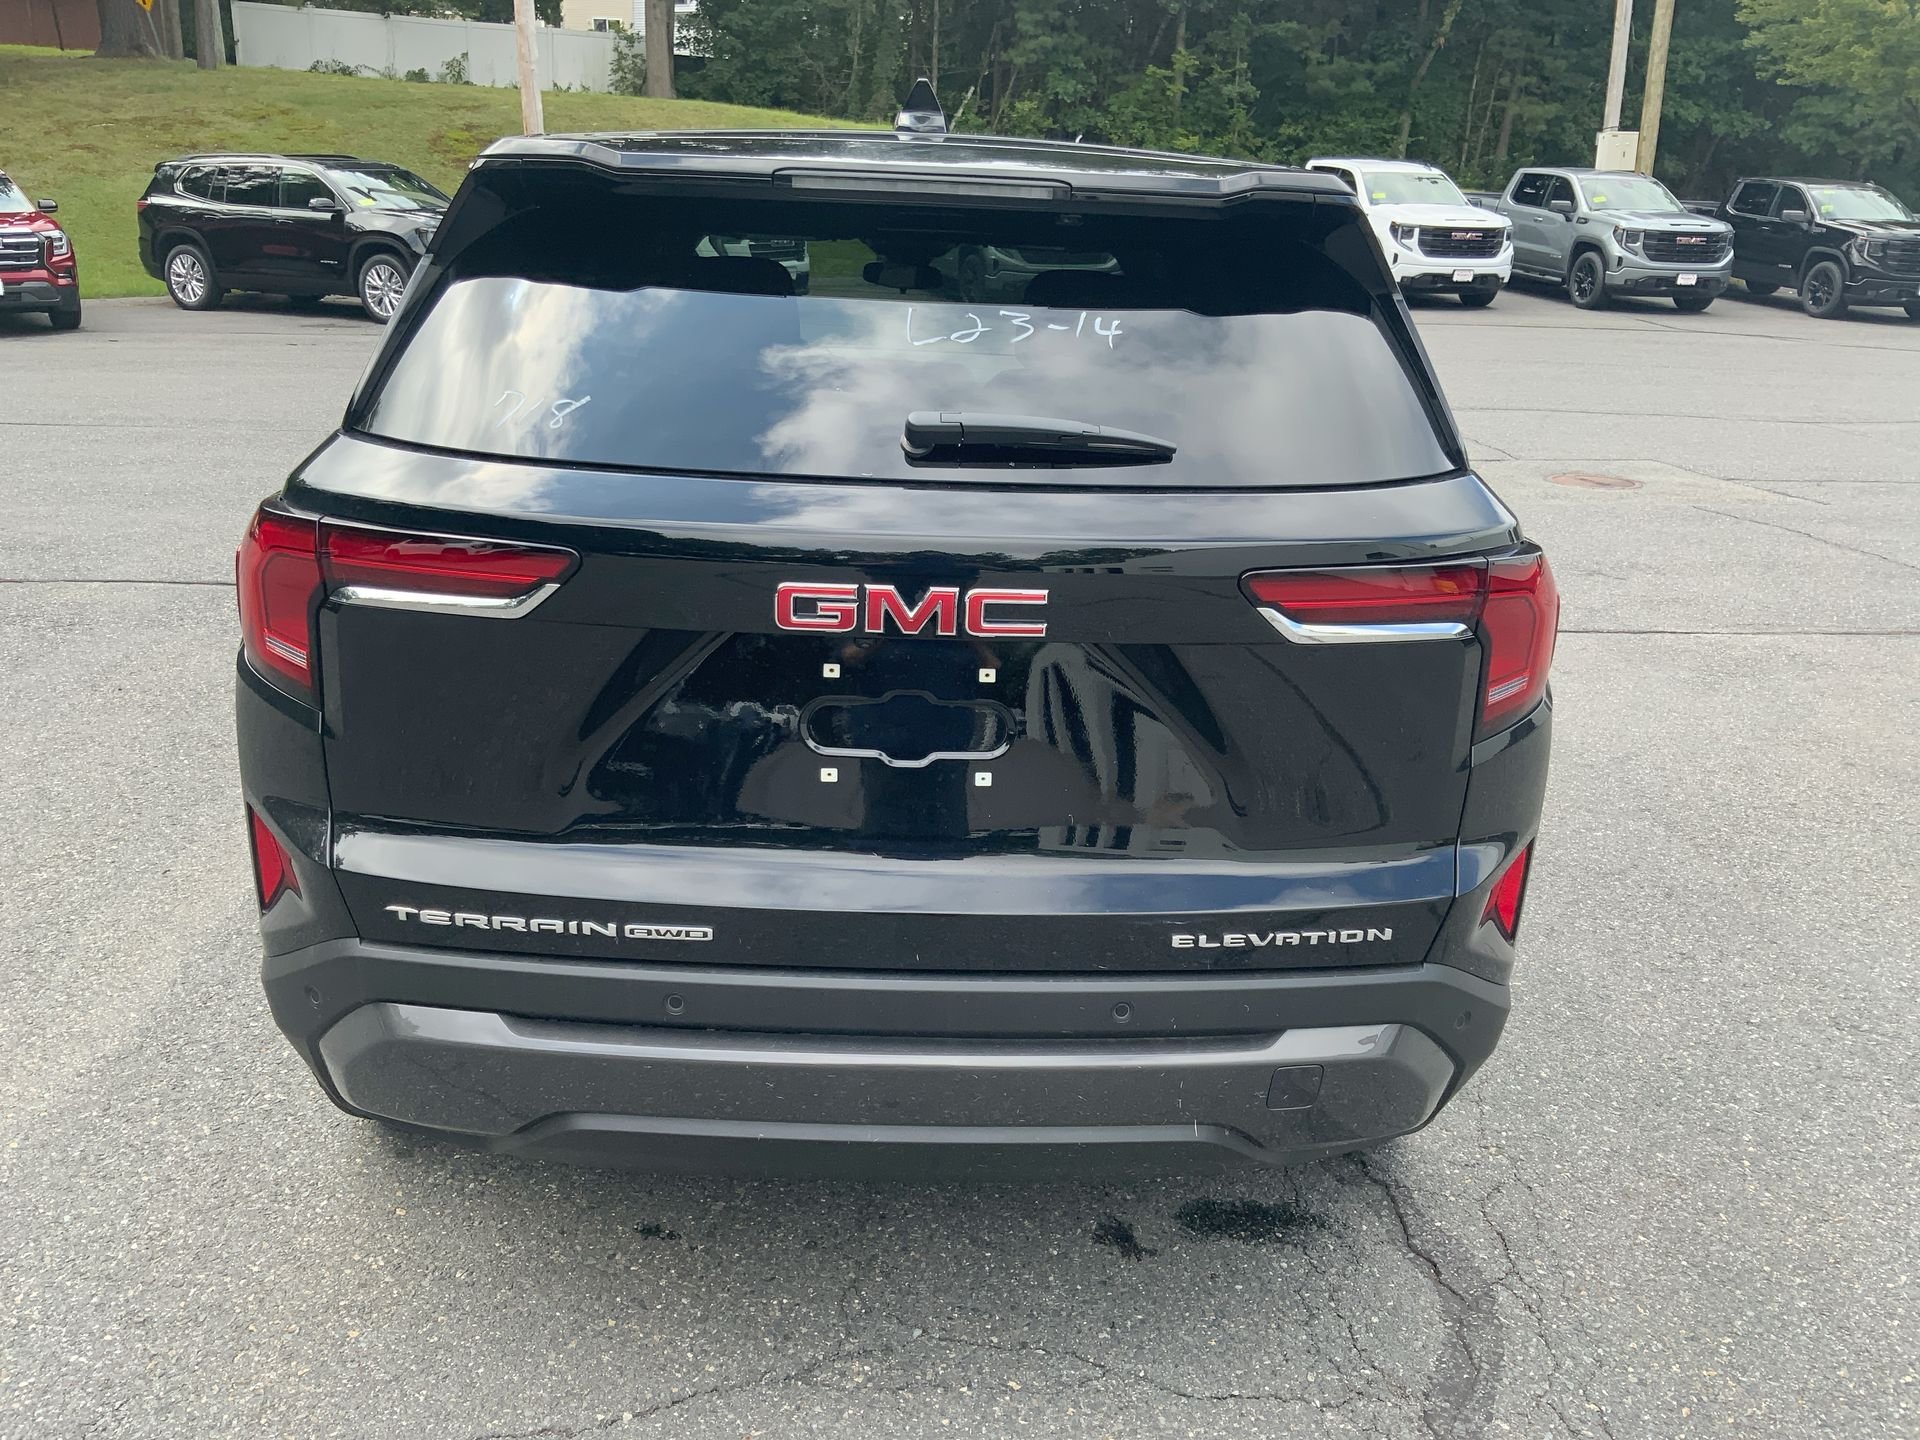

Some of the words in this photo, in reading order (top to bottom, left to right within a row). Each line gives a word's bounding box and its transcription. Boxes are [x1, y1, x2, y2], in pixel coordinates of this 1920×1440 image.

[775, 582, 1049, 637] GMC
[384, 905, 617, 937] TERRAIN
[628, 926, 711, 940] AWD
[1171, 928, 1393, 949] ELEVATION
